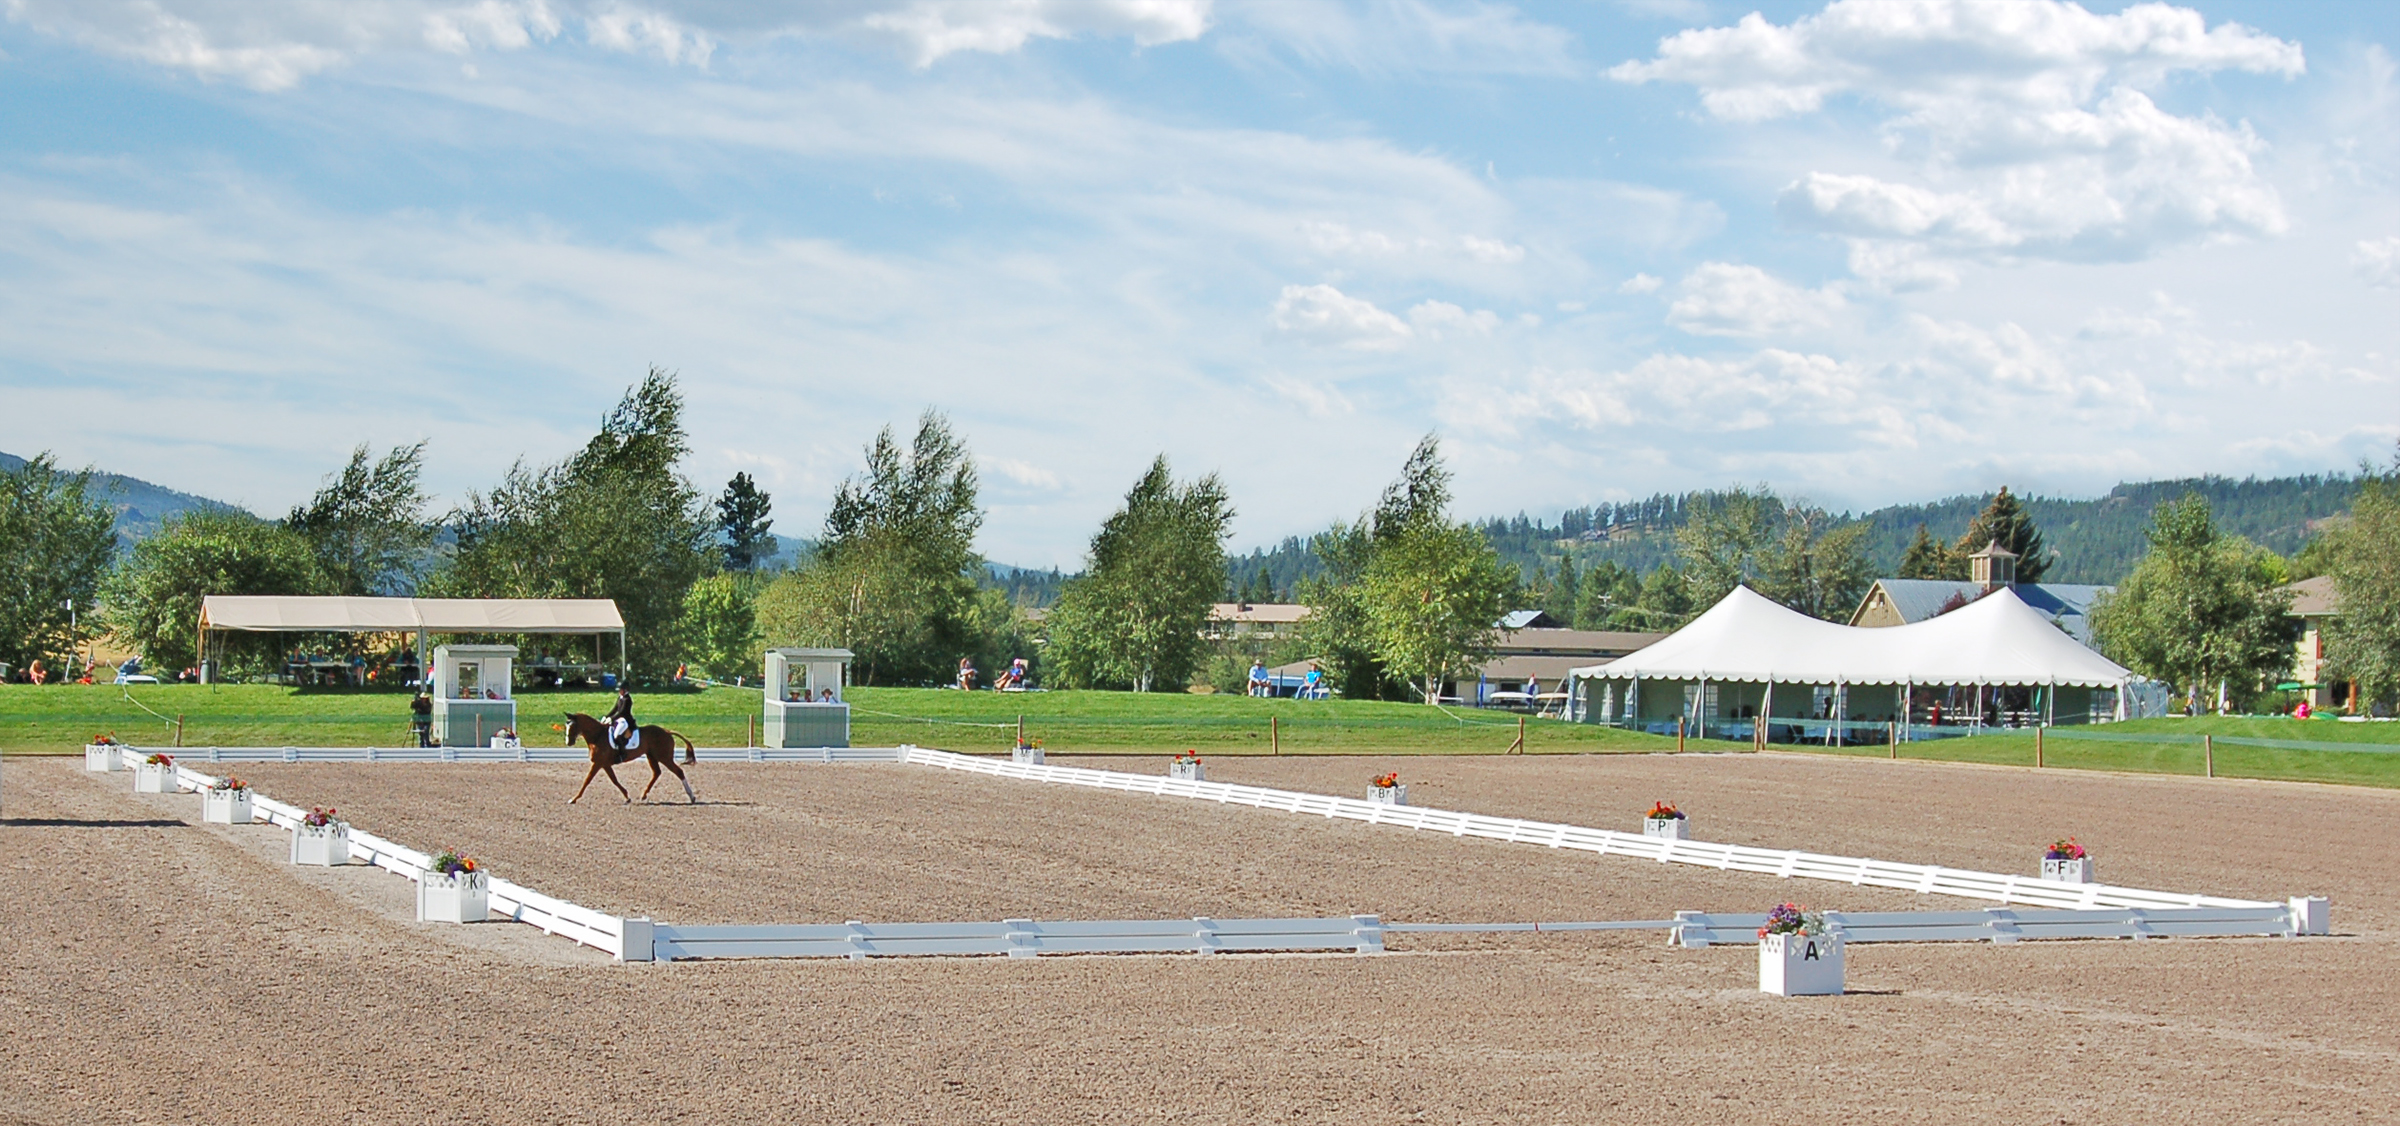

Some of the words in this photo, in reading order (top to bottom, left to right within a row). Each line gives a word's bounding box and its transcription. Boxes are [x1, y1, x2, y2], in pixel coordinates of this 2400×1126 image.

[1180, 764, 1187, 774] R
[238, 790, 244, 802] E
[1378, 788, 1385, 799] B
[335, 823, 343, 839] V
[1658, 820, 1666, 832] P
[2058, 860, 2067, 875] F
[470, 873, 478, 890] K
[1804, 940, 1820, 961] A
